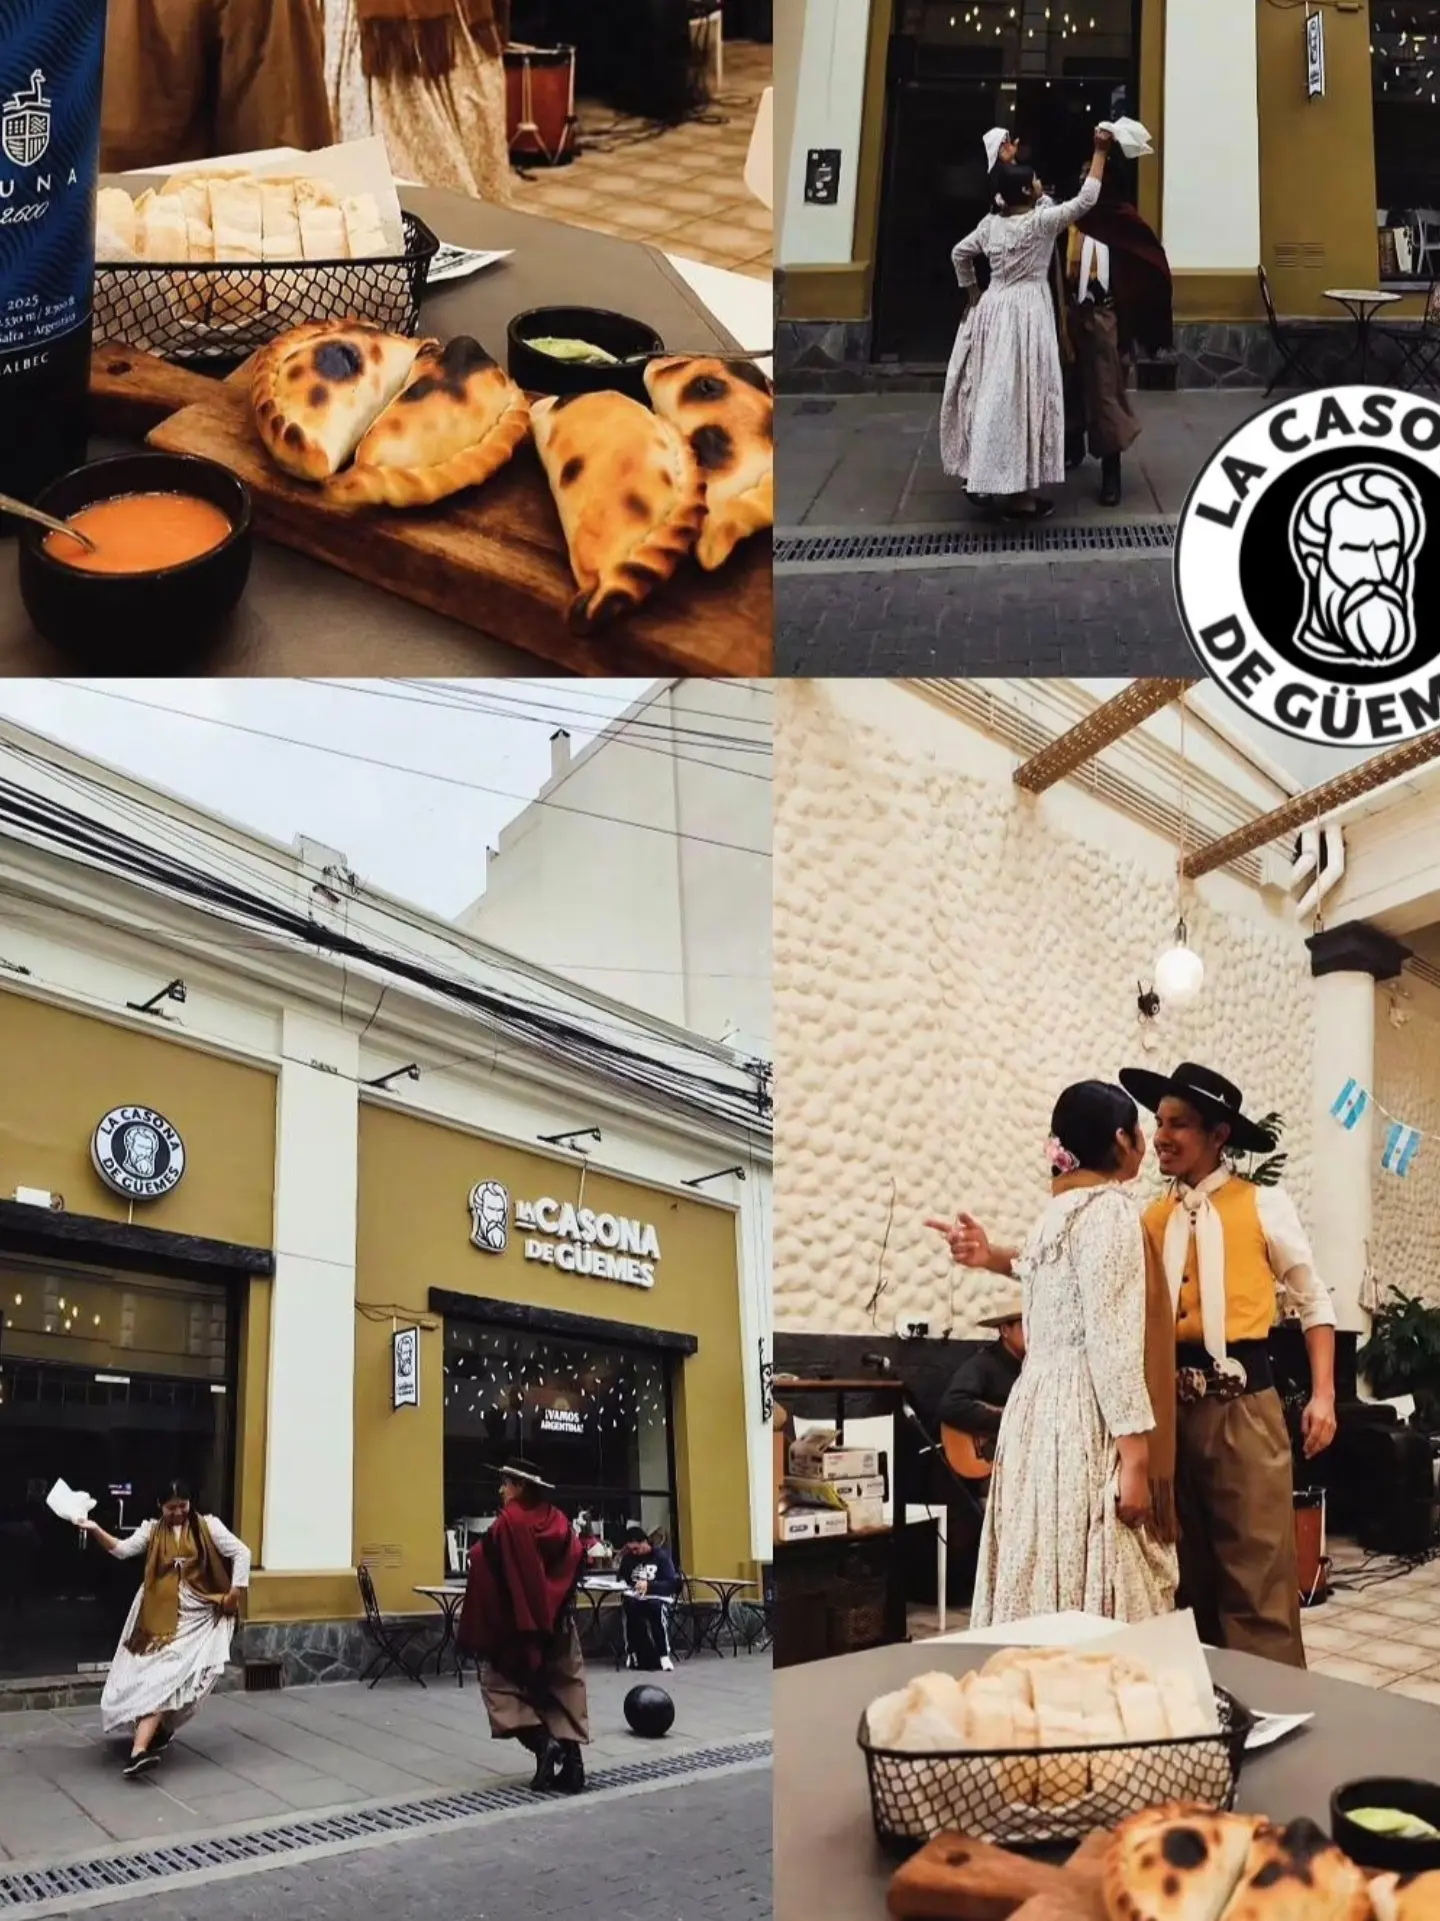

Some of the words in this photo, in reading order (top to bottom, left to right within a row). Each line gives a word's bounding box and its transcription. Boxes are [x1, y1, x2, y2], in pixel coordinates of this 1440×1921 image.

[7, 294, 39, 311] 2025
[0, 331, 24, 343] alta
[101, 1116, 119, 1135] LA
[120, 1108, 181, 1152] CASONA
[102, 1157, 122, 1181] DE
[514, 1199, 536, 1225] LA
[533, 1196, 662, 1261] CASONA
[524, 1238, 555, 1265] DE
[553, 1240, 656, 1289] GÜEMES
